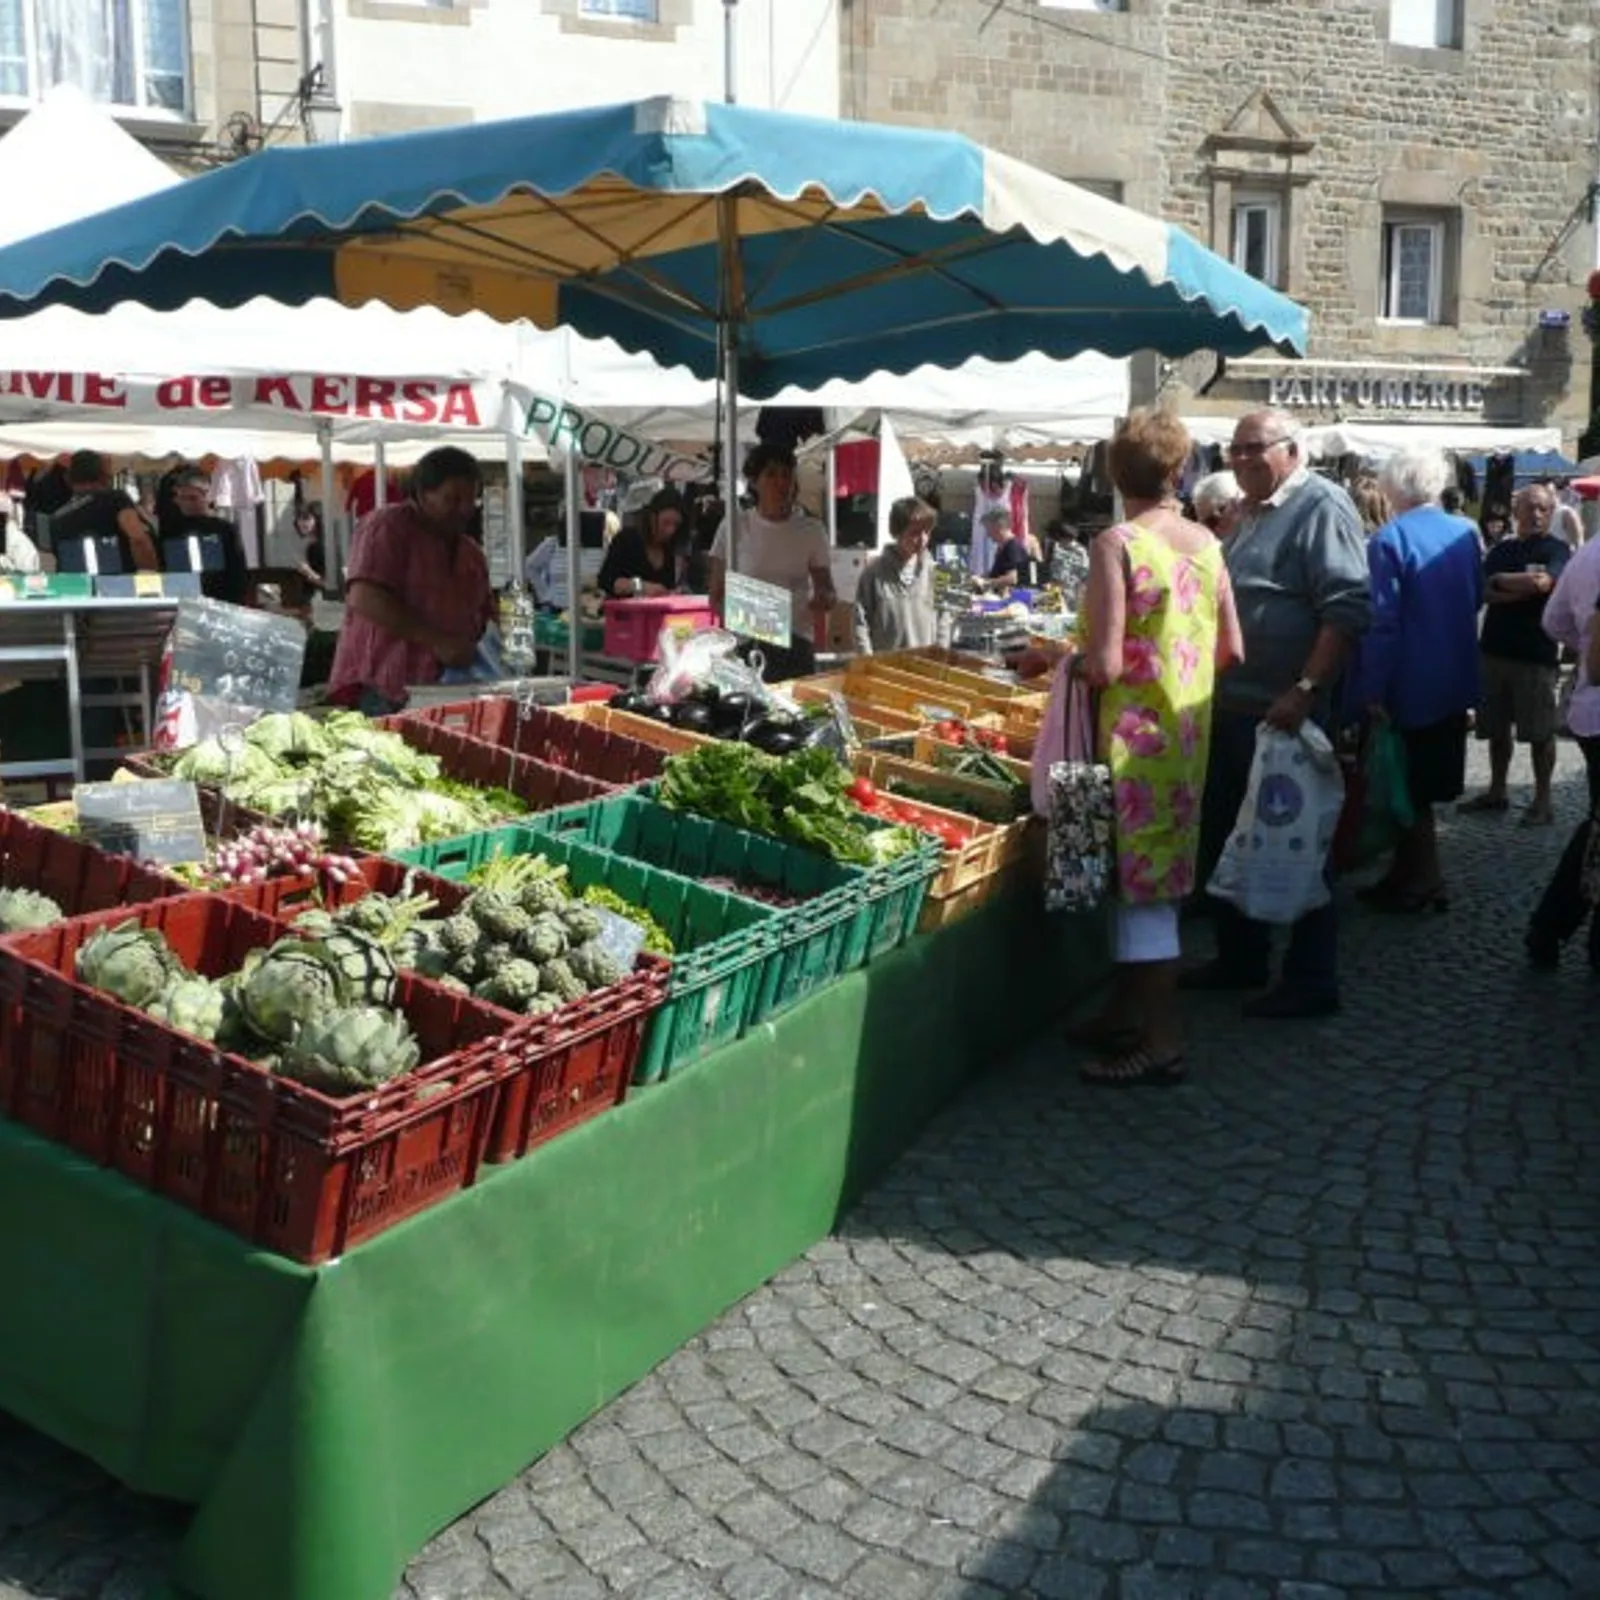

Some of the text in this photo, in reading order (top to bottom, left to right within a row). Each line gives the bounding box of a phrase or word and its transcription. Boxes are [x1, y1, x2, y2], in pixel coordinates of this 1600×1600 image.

[156, 375, 232, 409] de
[255, 375, 481, 426] KERSA
[1268, 377, 1484, 409] PARFUMERIE
